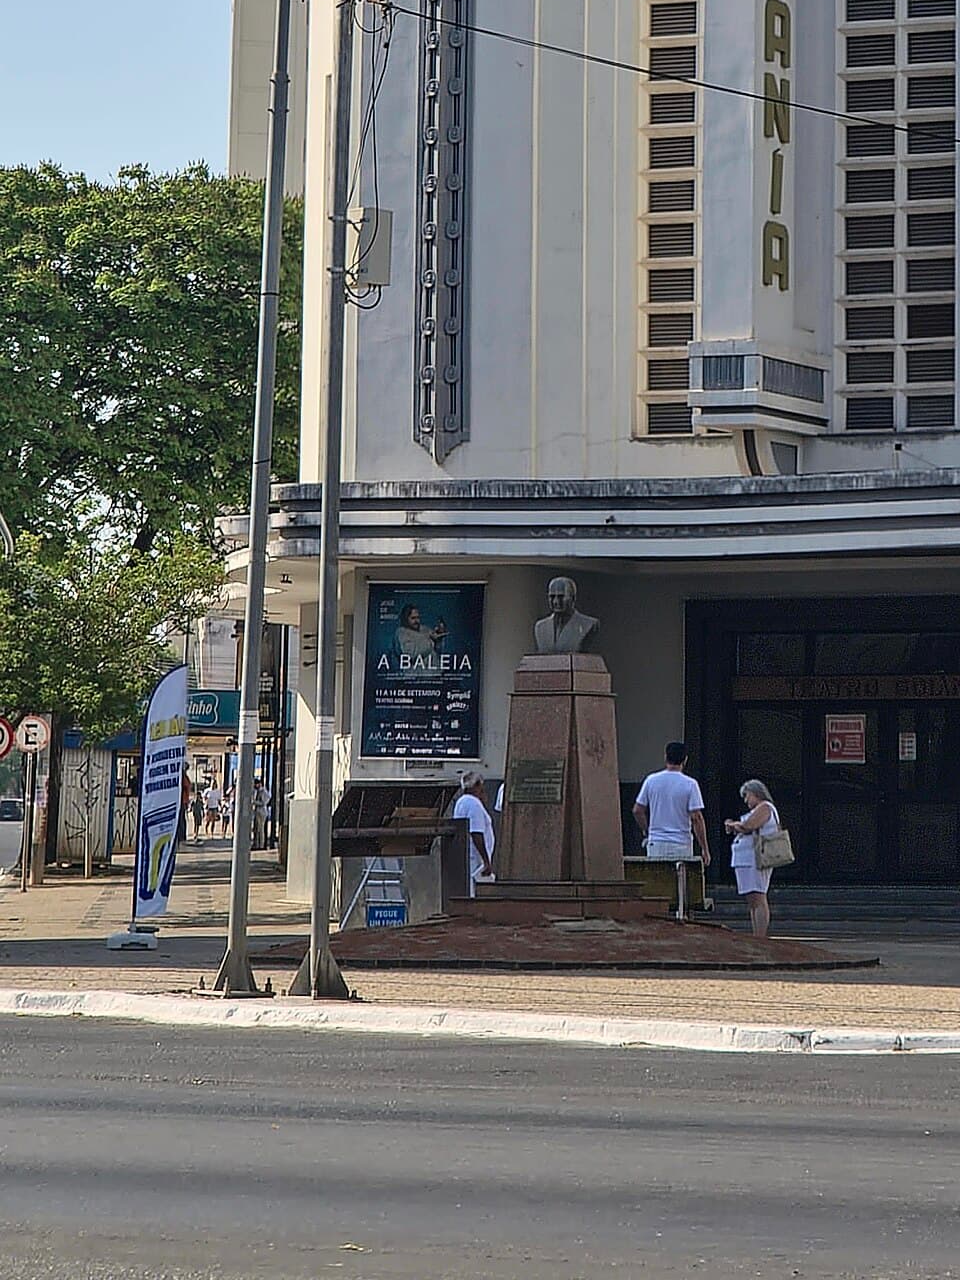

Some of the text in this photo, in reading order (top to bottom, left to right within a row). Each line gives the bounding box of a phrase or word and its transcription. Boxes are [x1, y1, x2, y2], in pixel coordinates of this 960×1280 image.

[377, 654, 472, 670] A BALEIA
[25, 724, 38, 745] E
